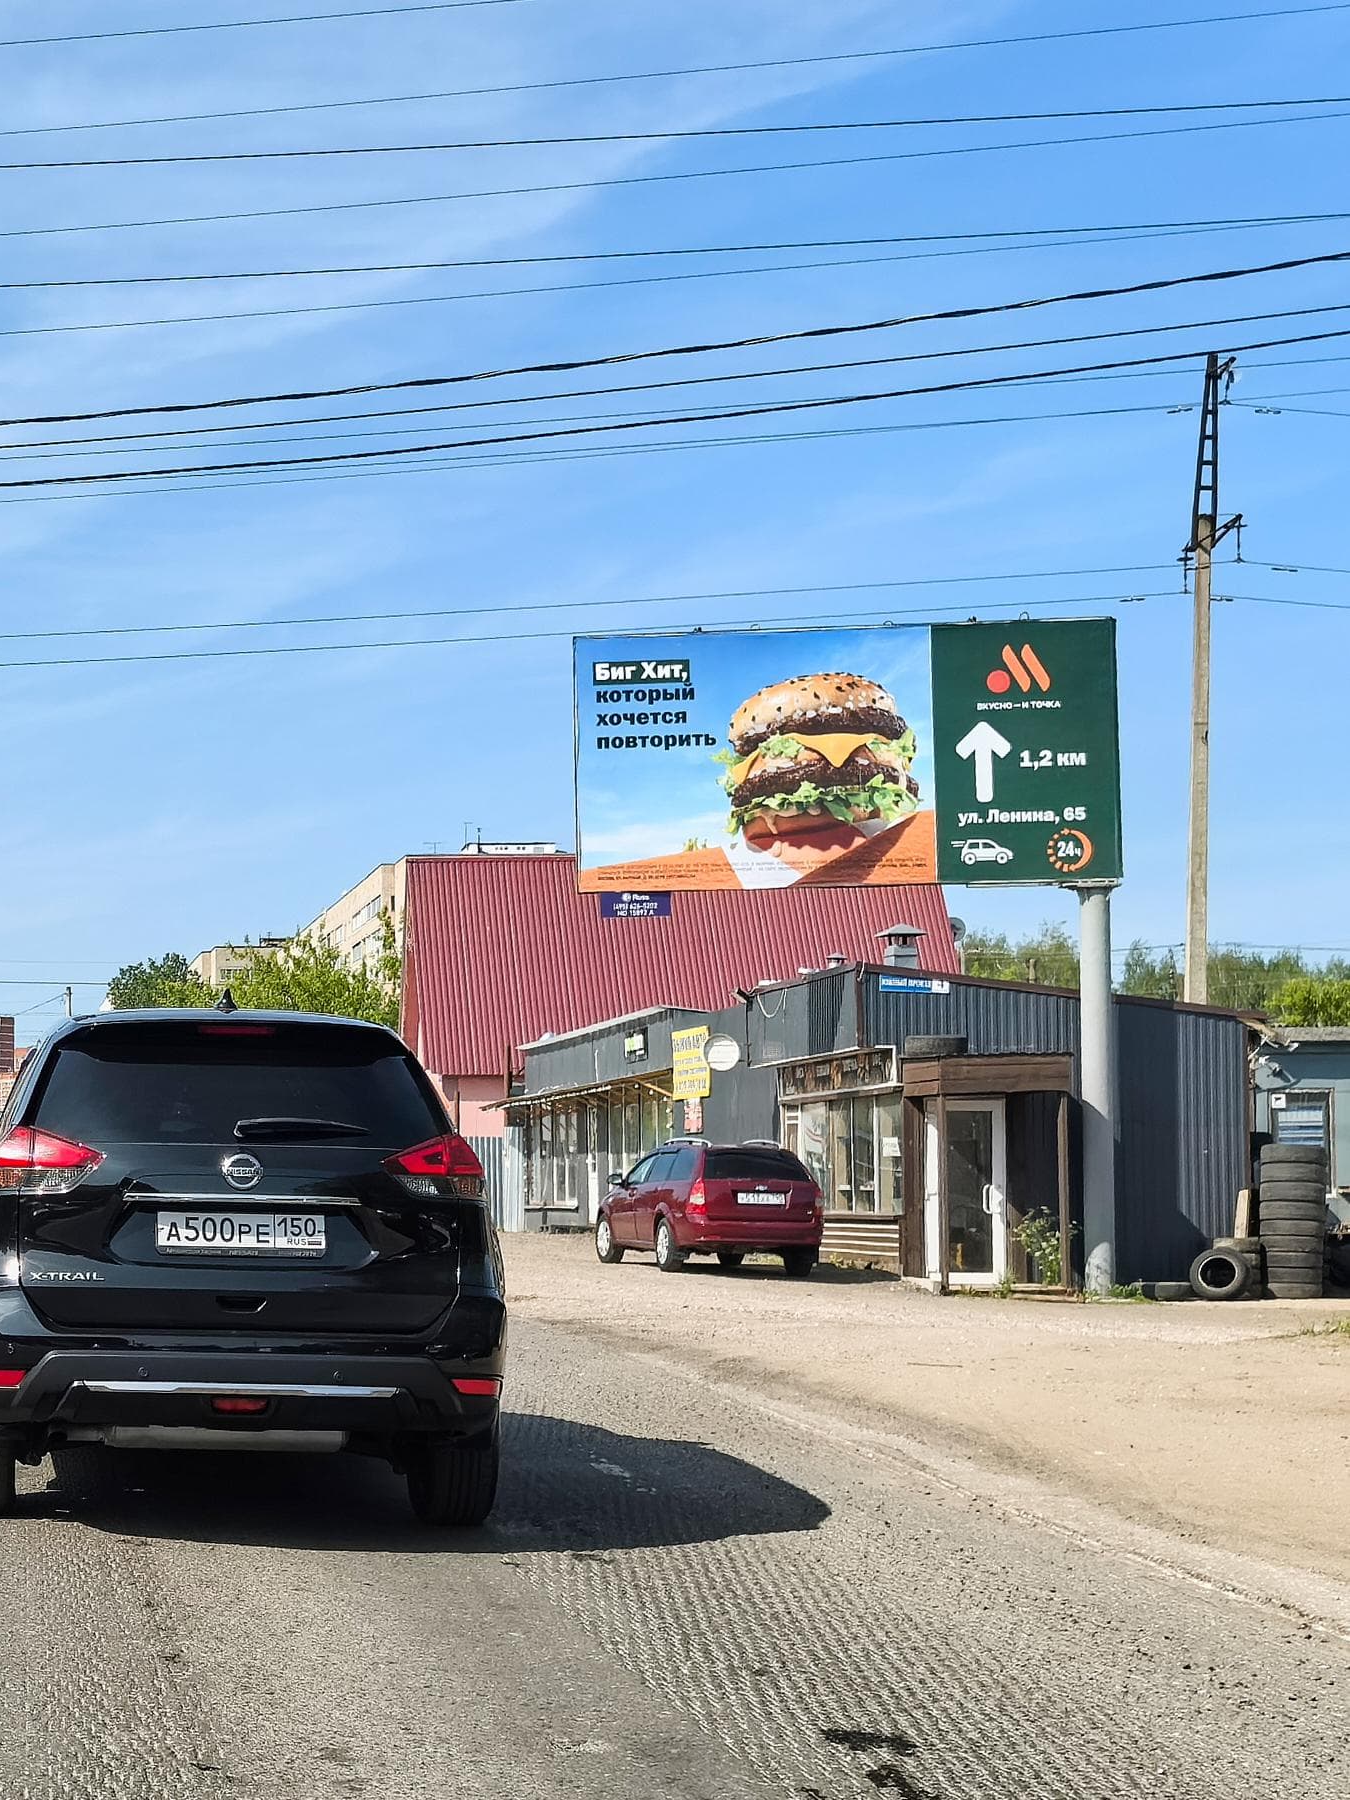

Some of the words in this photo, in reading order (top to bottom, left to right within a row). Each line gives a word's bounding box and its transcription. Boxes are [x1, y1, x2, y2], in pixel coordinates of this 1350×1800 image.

[595, 663, 636, 681] Биг
[640, 661, 688, 682] Хит,
[596, 682, 695, 705] который
[1030, 700, 1062, 709] ТОЧКА
[596, 711, 687, 726] хочется
[597, 733, 717, 750] повторить
[1019, 750, 1053, 771] 1,2
[1057, 752, 1087, 766] км
[957, 811, 983, 827] ул.
[986, 808, 1060, 825] Ленина,
[1063, 806, 1087, 821] 65
[276, 1217, 317, 1238] 150
[287, 1238, 307, 1246] RUS
[30, 1271, 106, 1281] X-TRAIL
